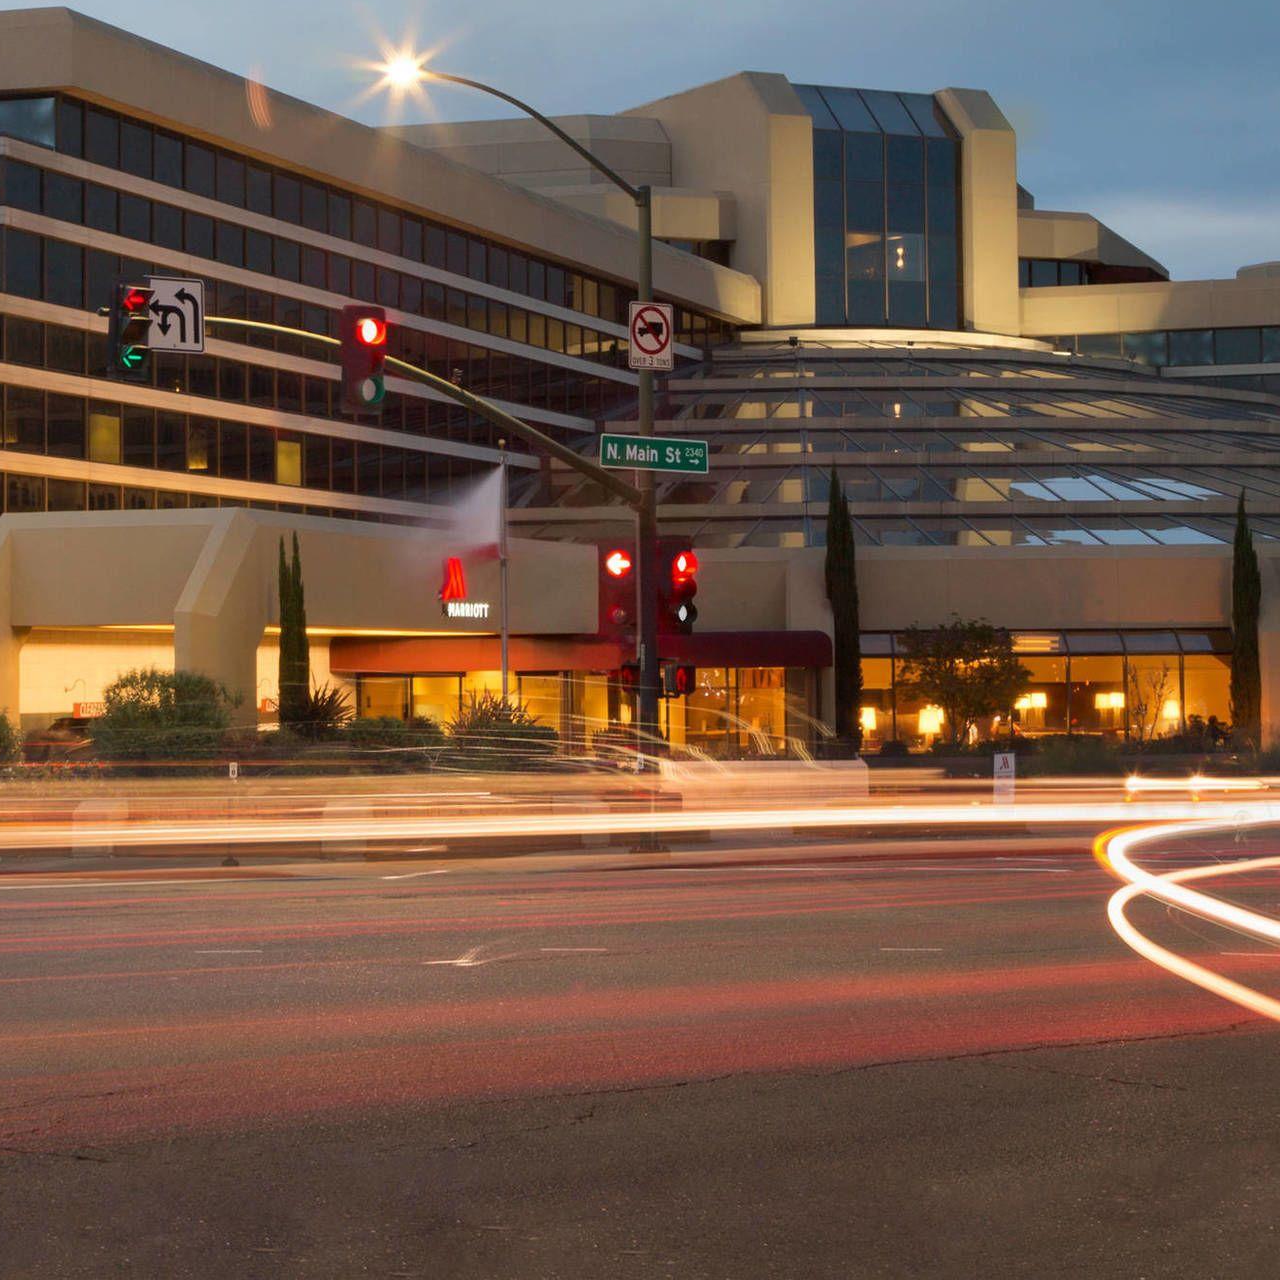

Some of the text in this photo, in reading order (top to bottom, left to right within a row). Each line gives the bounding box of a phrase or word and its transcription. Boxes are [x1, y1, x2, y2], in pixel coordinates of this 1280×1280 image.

[607, 442, 681, 463] N. Main St
[684, 447, 704, 457] 2340
[447, 602, 489, 618] MARRIOTT
